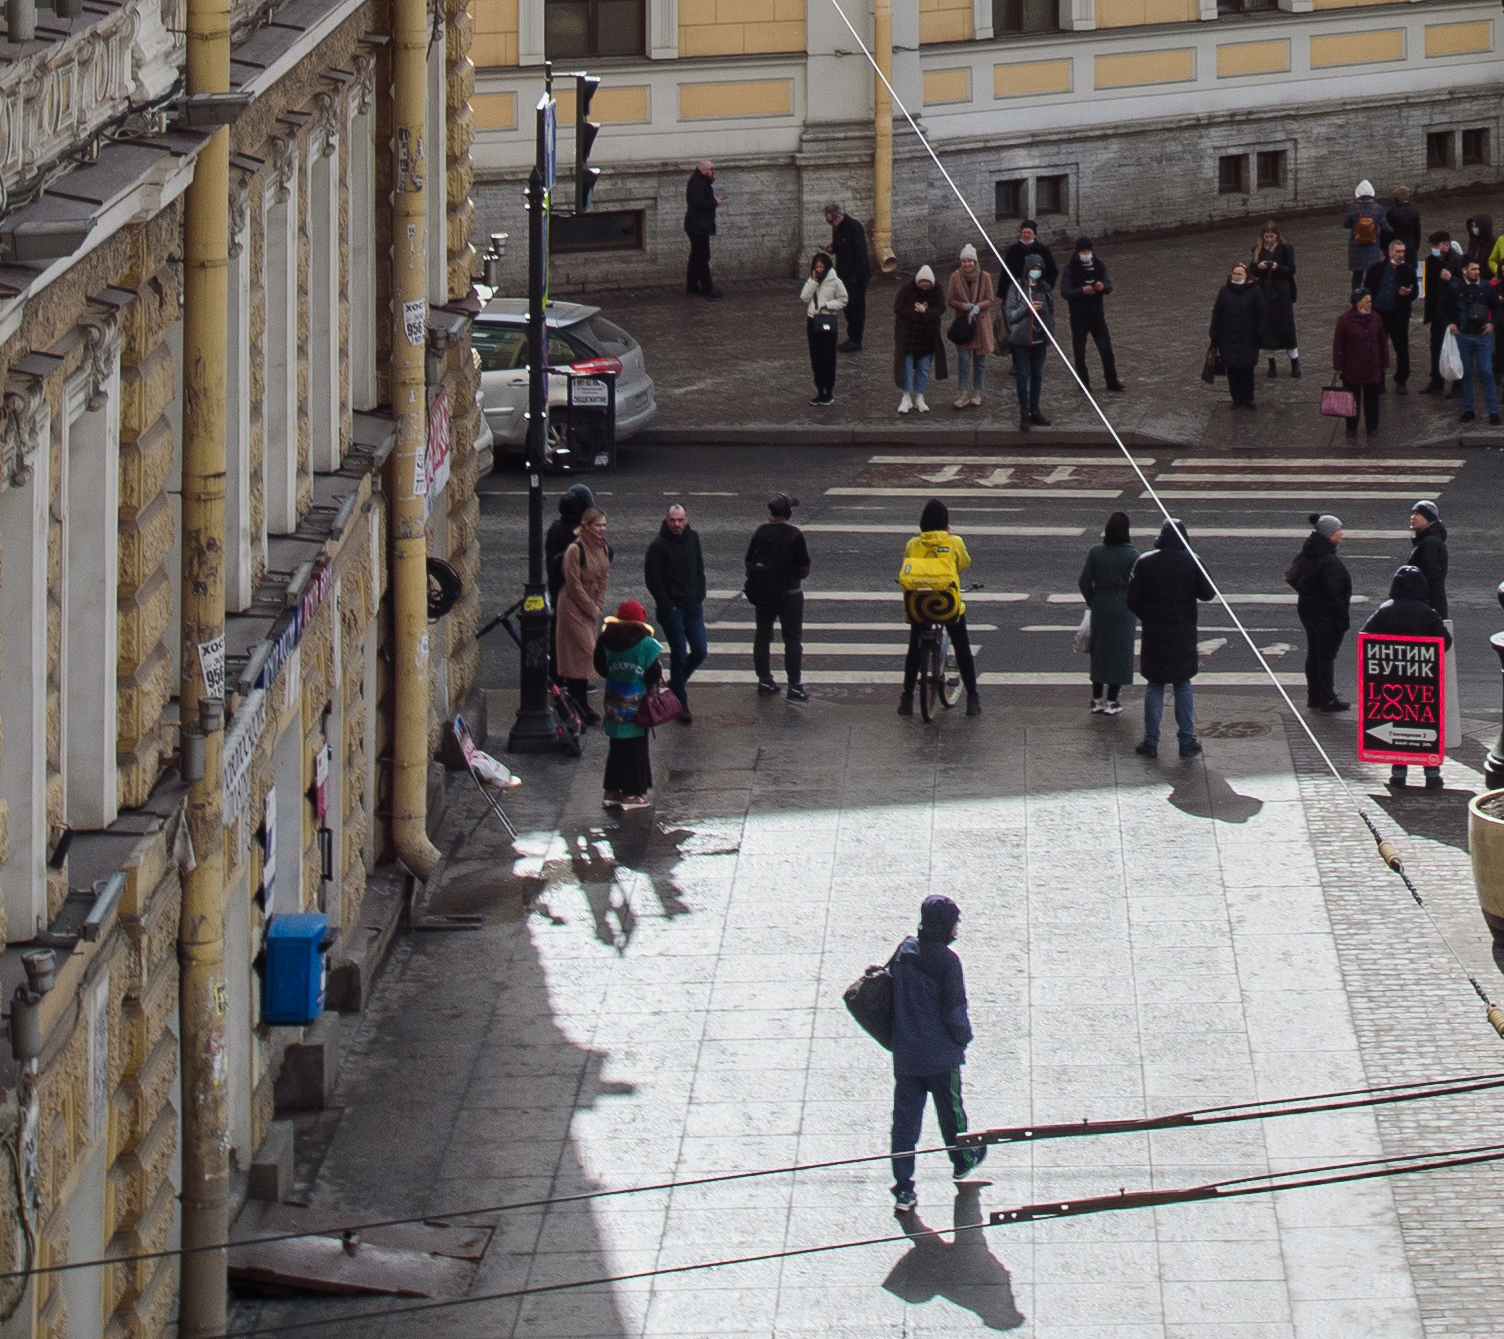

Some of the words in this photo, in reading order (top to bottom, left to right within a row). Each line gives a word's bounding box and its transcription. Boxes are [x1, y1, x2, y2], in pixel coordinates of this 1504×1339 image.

[1367, 643, 1435, 661] ИНТИМ
[1368, 660, 1434, 678] БУТИК
[1368, 682, 1436, 703] LOVE
[1367, 702, 1436, 723] ZONA
